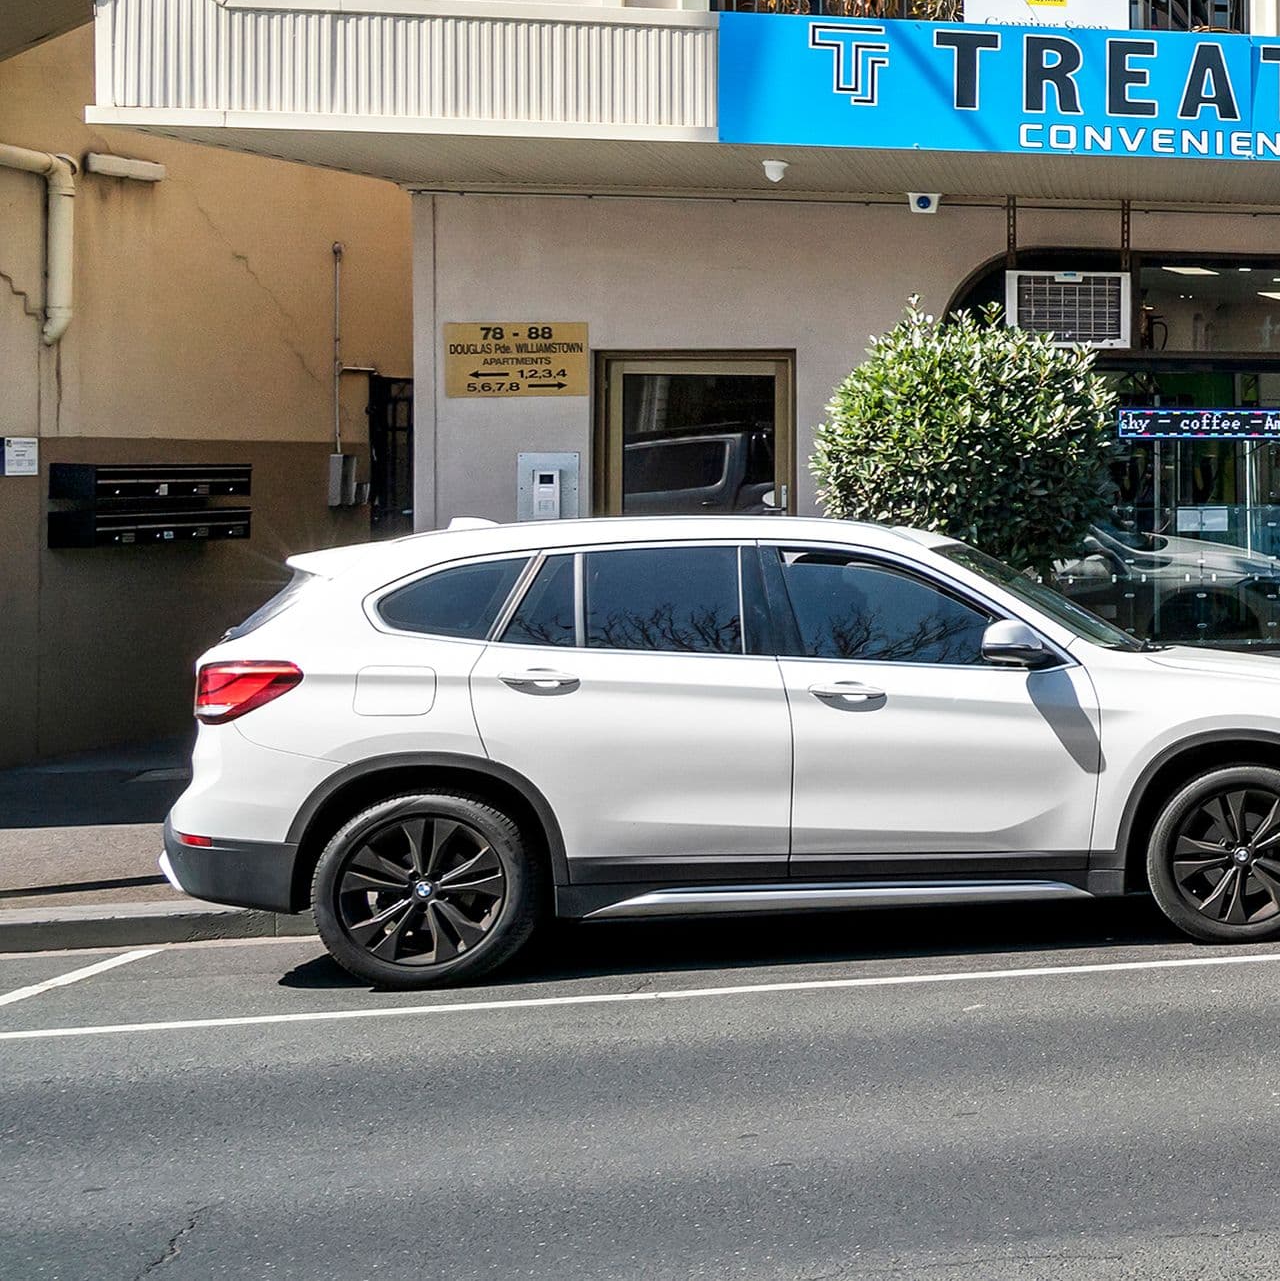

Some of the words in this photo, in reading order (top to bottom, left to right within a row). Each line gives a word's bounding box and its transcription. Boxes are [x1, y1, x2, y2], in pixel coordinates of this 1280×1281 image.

[480, 327, 504, 340] 78
[527, 327, 553, 340] 88
[449, 344, 492, 355] DOUGLAS
[516, 343, 583, 353] WILLIAMSTOWN
[482, 357, 551, 365] APARTMENTS
